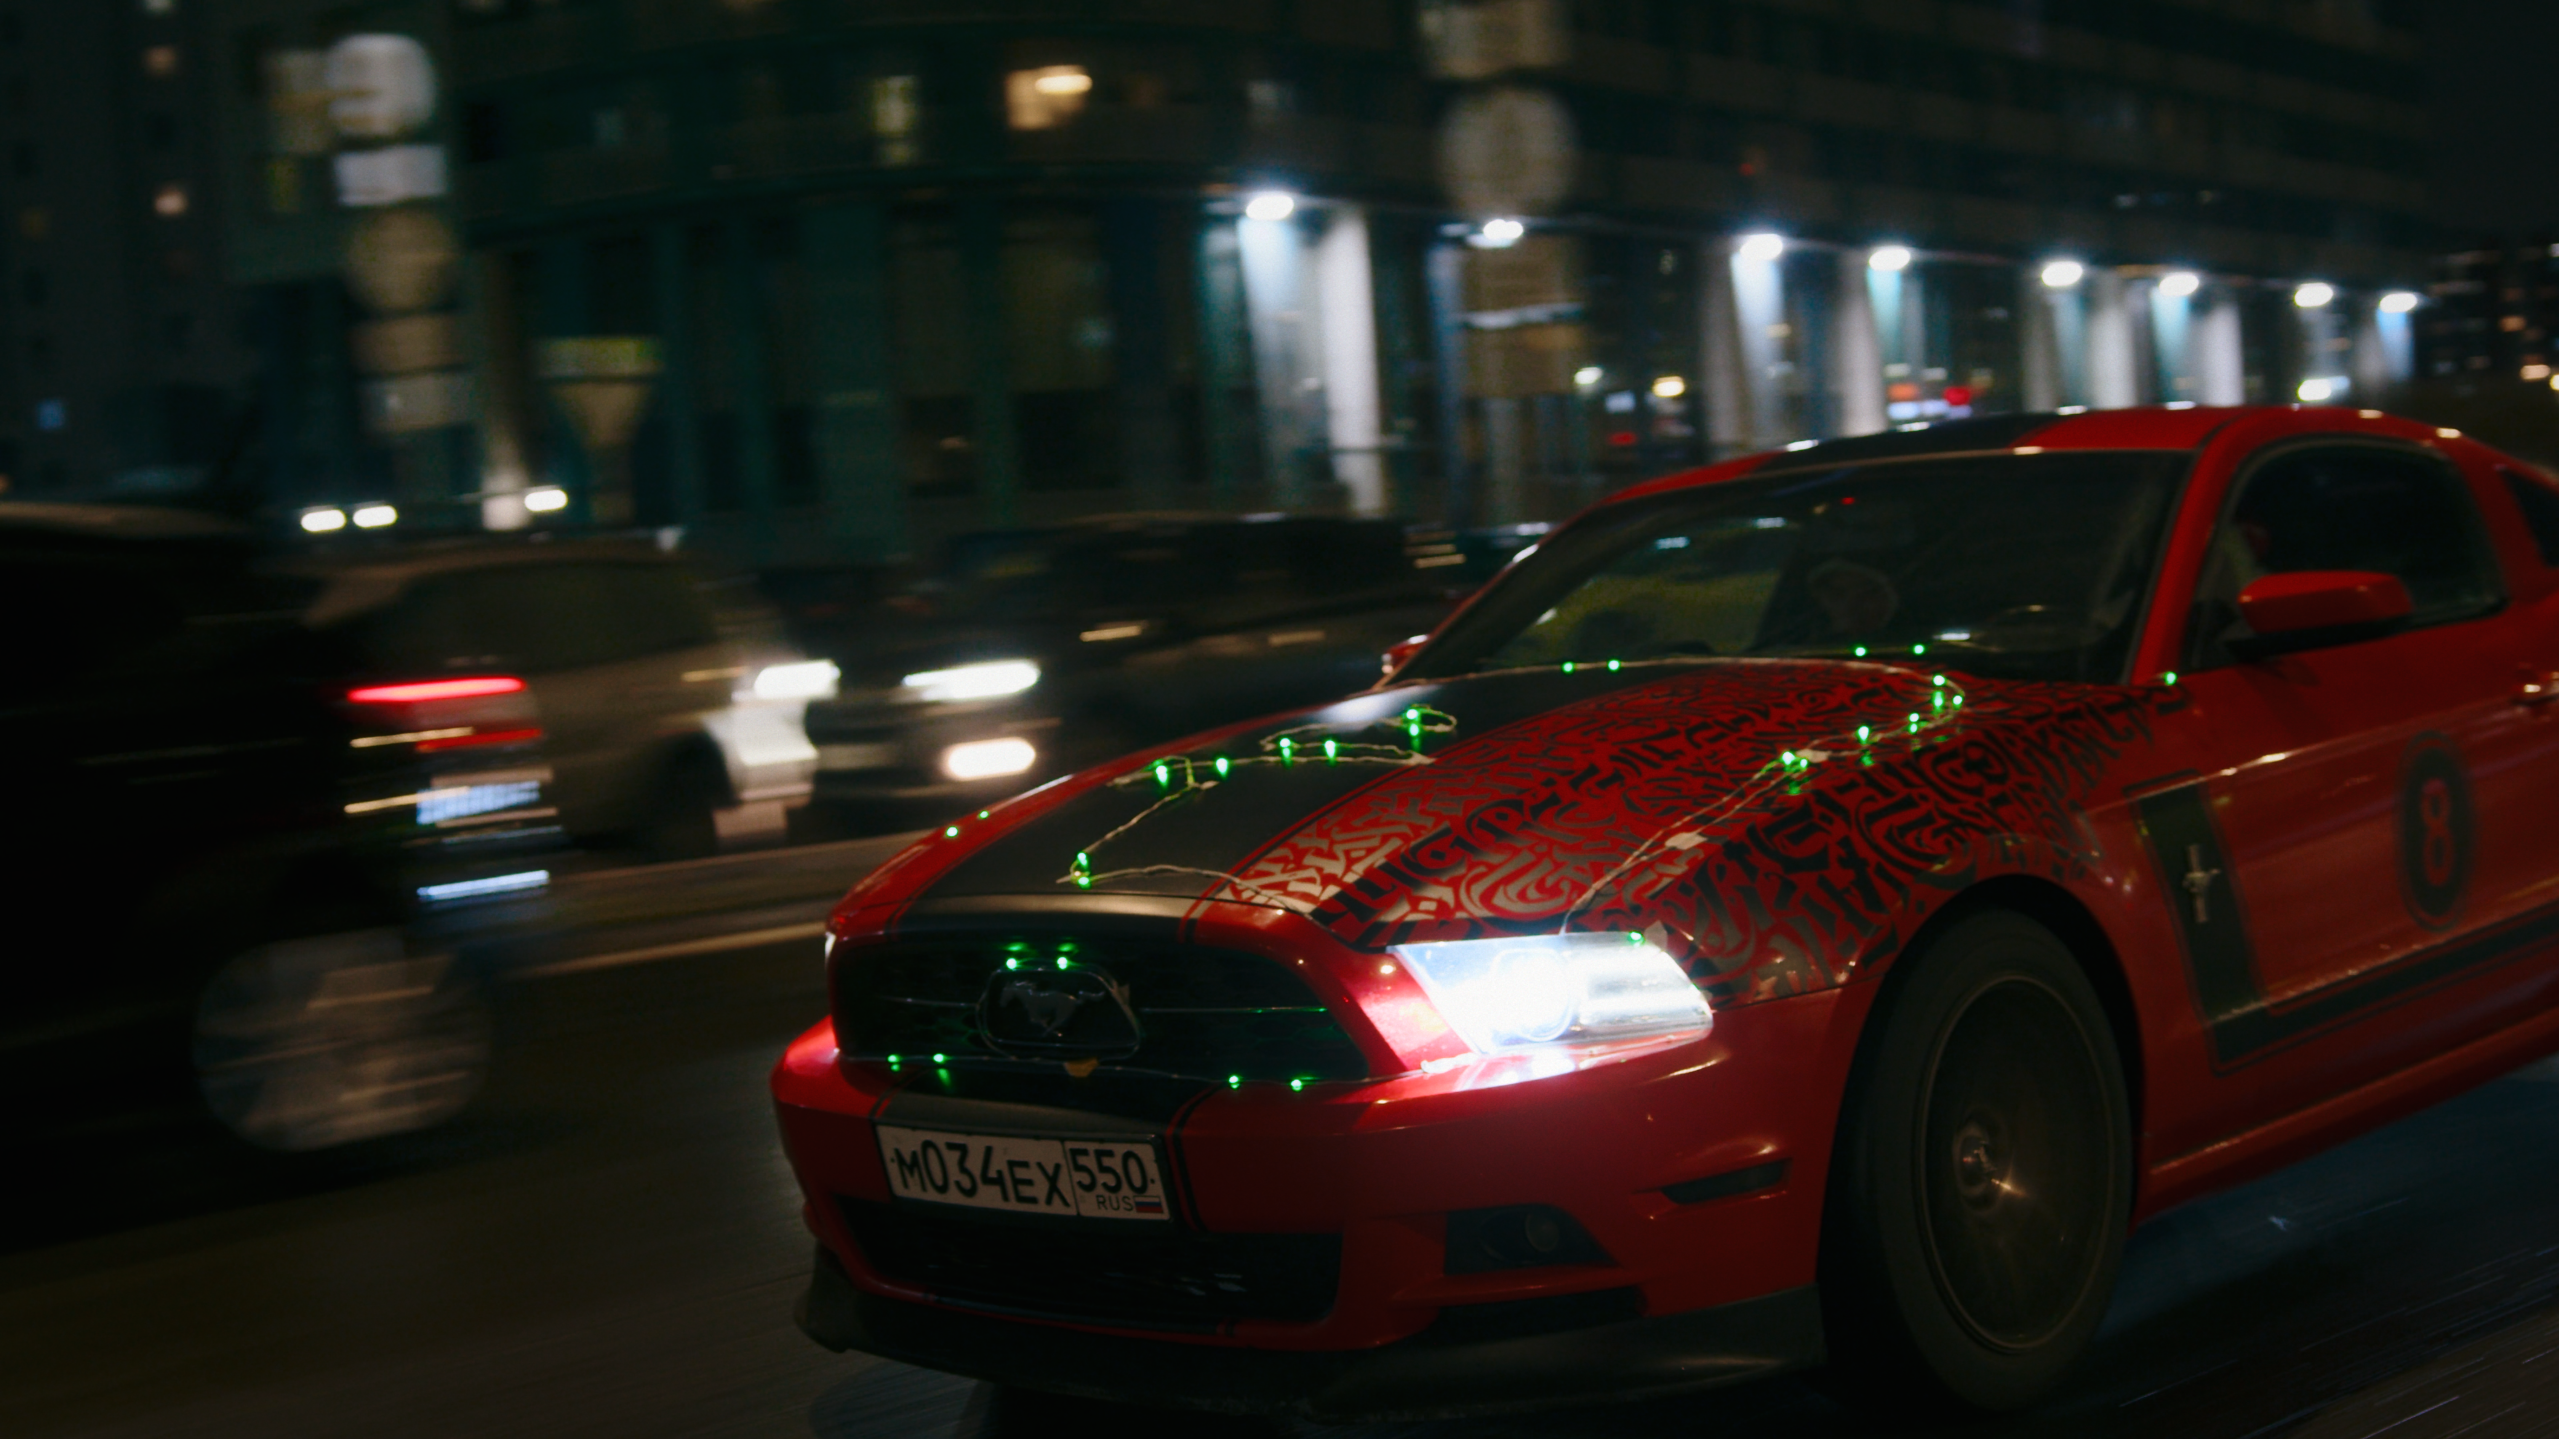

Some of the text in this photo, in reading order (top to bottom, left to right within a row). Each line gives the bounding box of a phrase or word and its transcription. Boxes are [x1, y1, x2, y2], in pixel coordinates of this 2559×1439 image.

[2421, 777, 2453, 886] 8
[1071, 1147, 1149, 1195] 550
[1096, 1194, 1134, 1212] RUS
